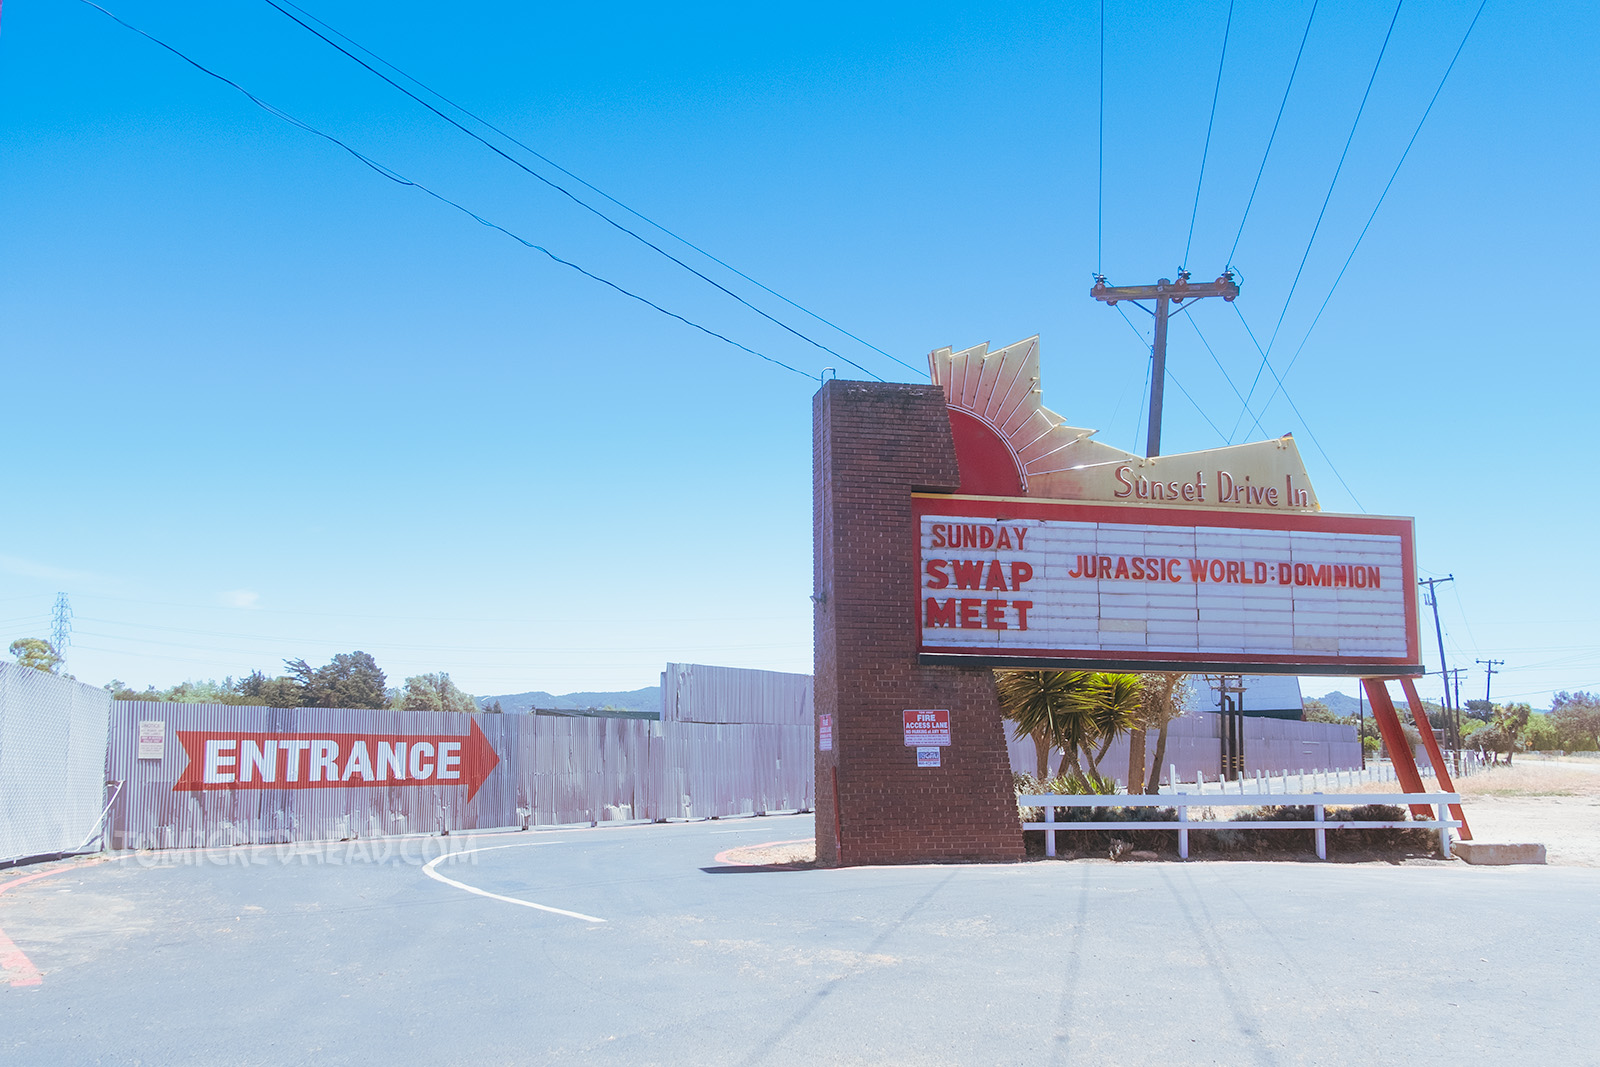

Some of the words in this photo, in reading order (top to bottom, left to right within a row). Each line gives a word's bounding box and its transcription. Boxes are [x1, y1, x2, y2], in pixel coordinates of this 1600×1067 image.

[1114, 465, 1207, 502] Sunset
[1217, 470, 1279, 506] Drive
[1286, 474, 1309, 508] In
[931, 524, 1028, 550] SUNDAY
[926, 559, 1033, 592] SWAP
[1068, 555, 1182, 583] JURASSIC
[926, 597, 1033, 631] MEET
[203, 739, 462, 784] ENTRANCE
